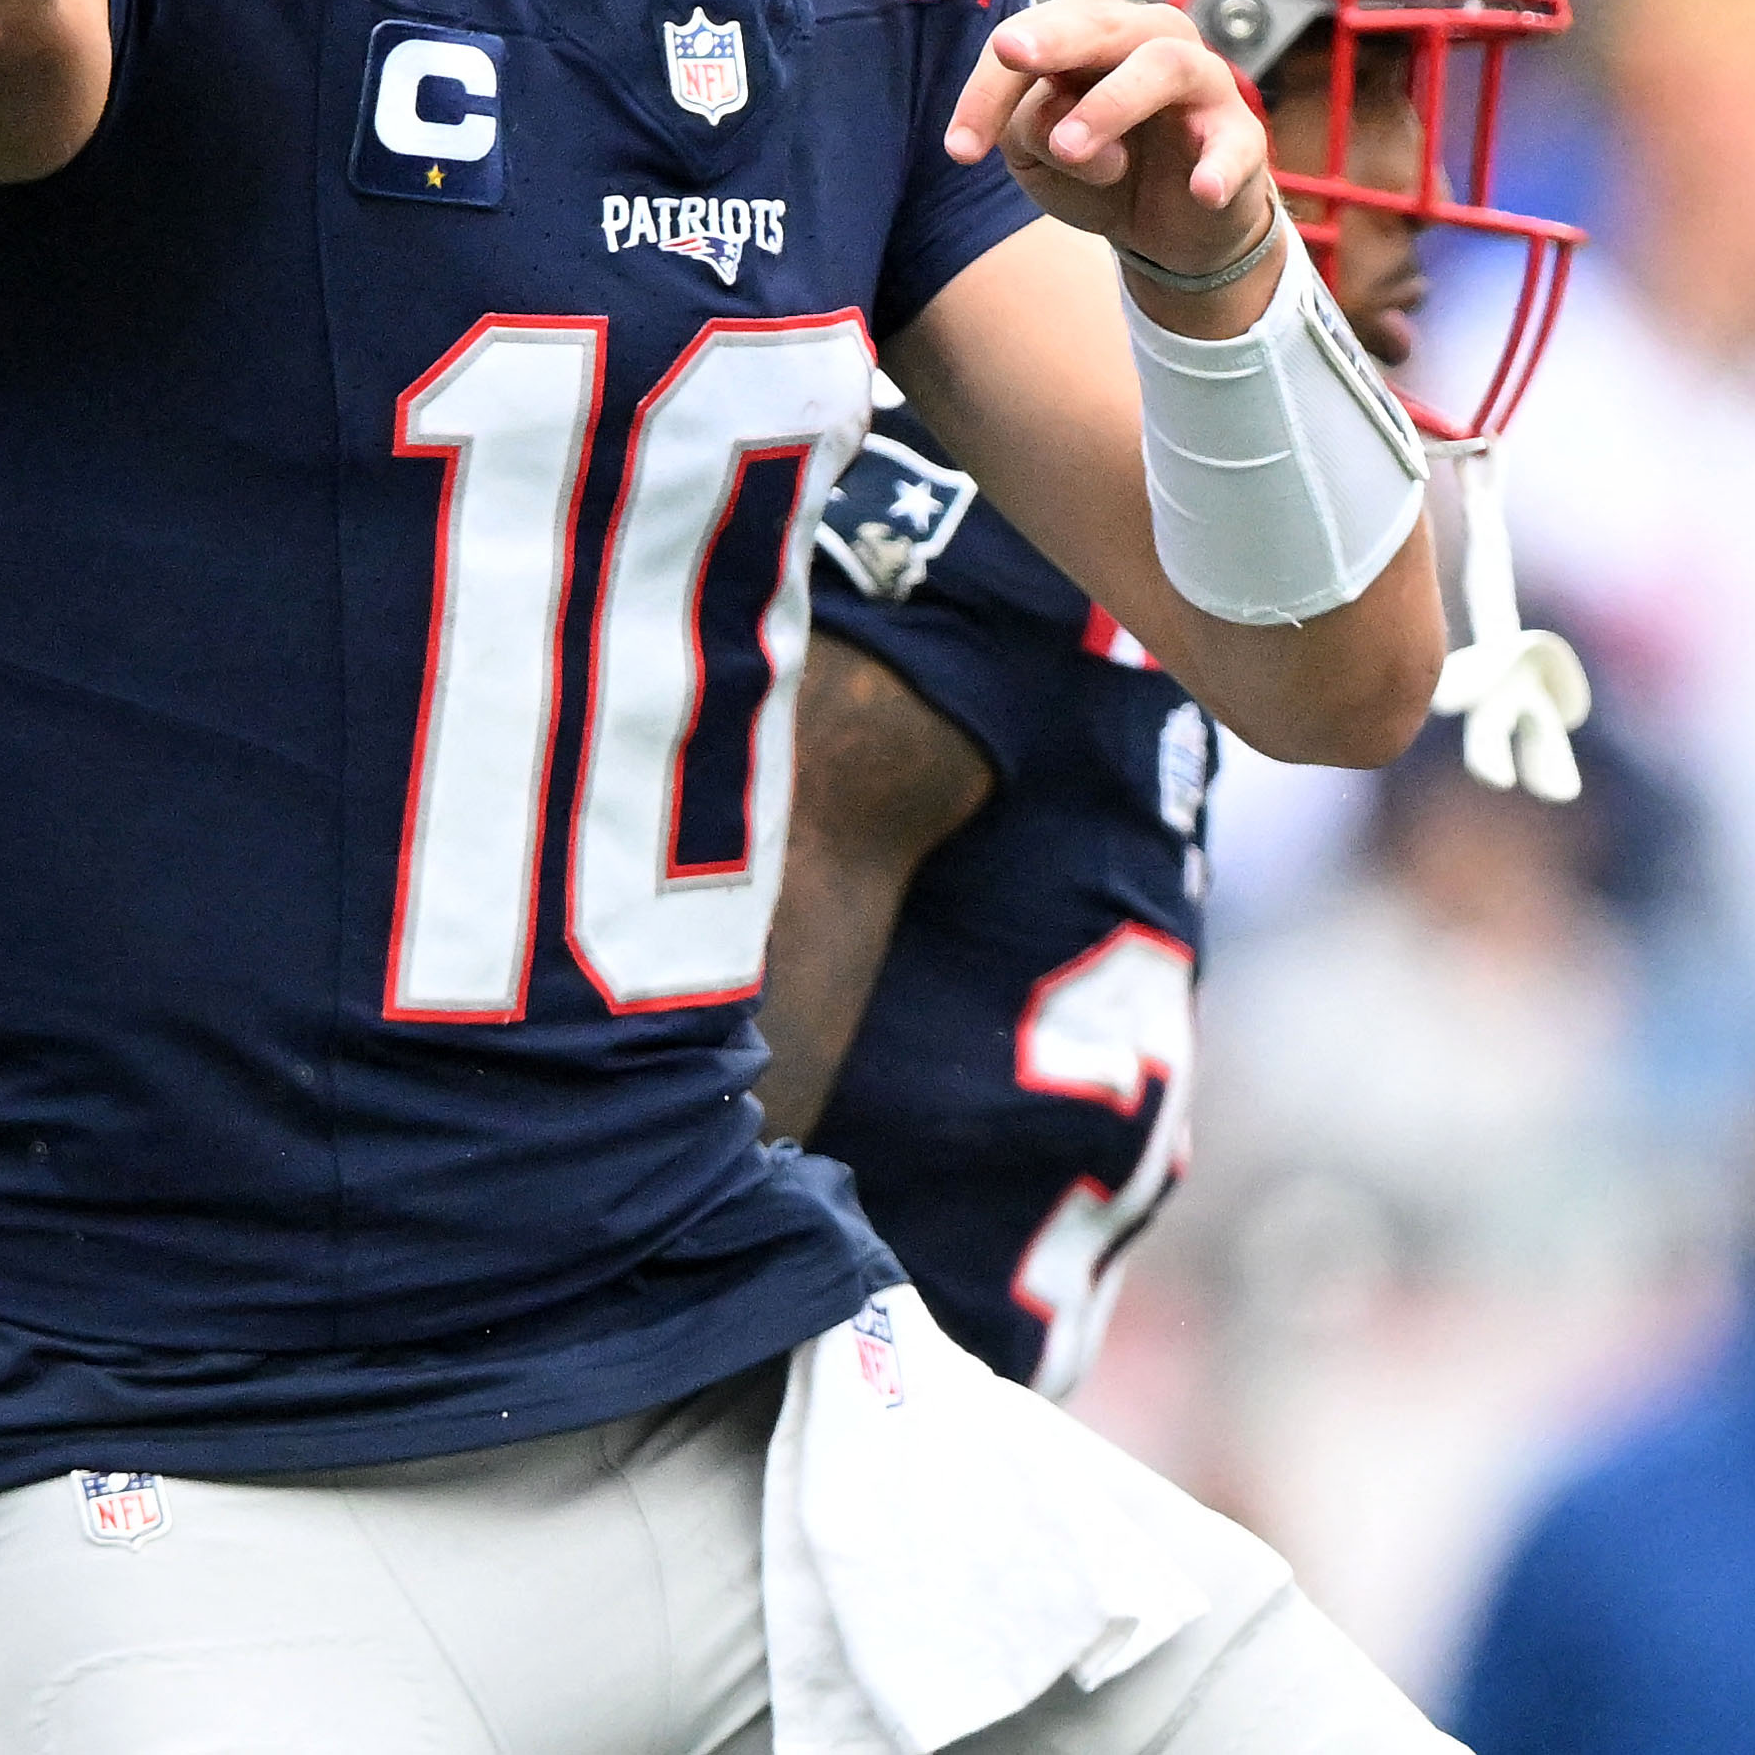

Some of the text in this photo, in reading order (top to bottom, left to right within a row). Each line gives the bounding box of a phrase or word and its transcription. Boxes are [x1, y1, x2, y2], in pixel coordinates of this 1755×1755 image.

[374, 38, 498, 162] C
[682, 63, 736, 103] NFL
[600, 194, 787, 256] PATRIOTS
[382, 306, 879, 1023] 10
[95, 1494, 159, 1533] NFL
